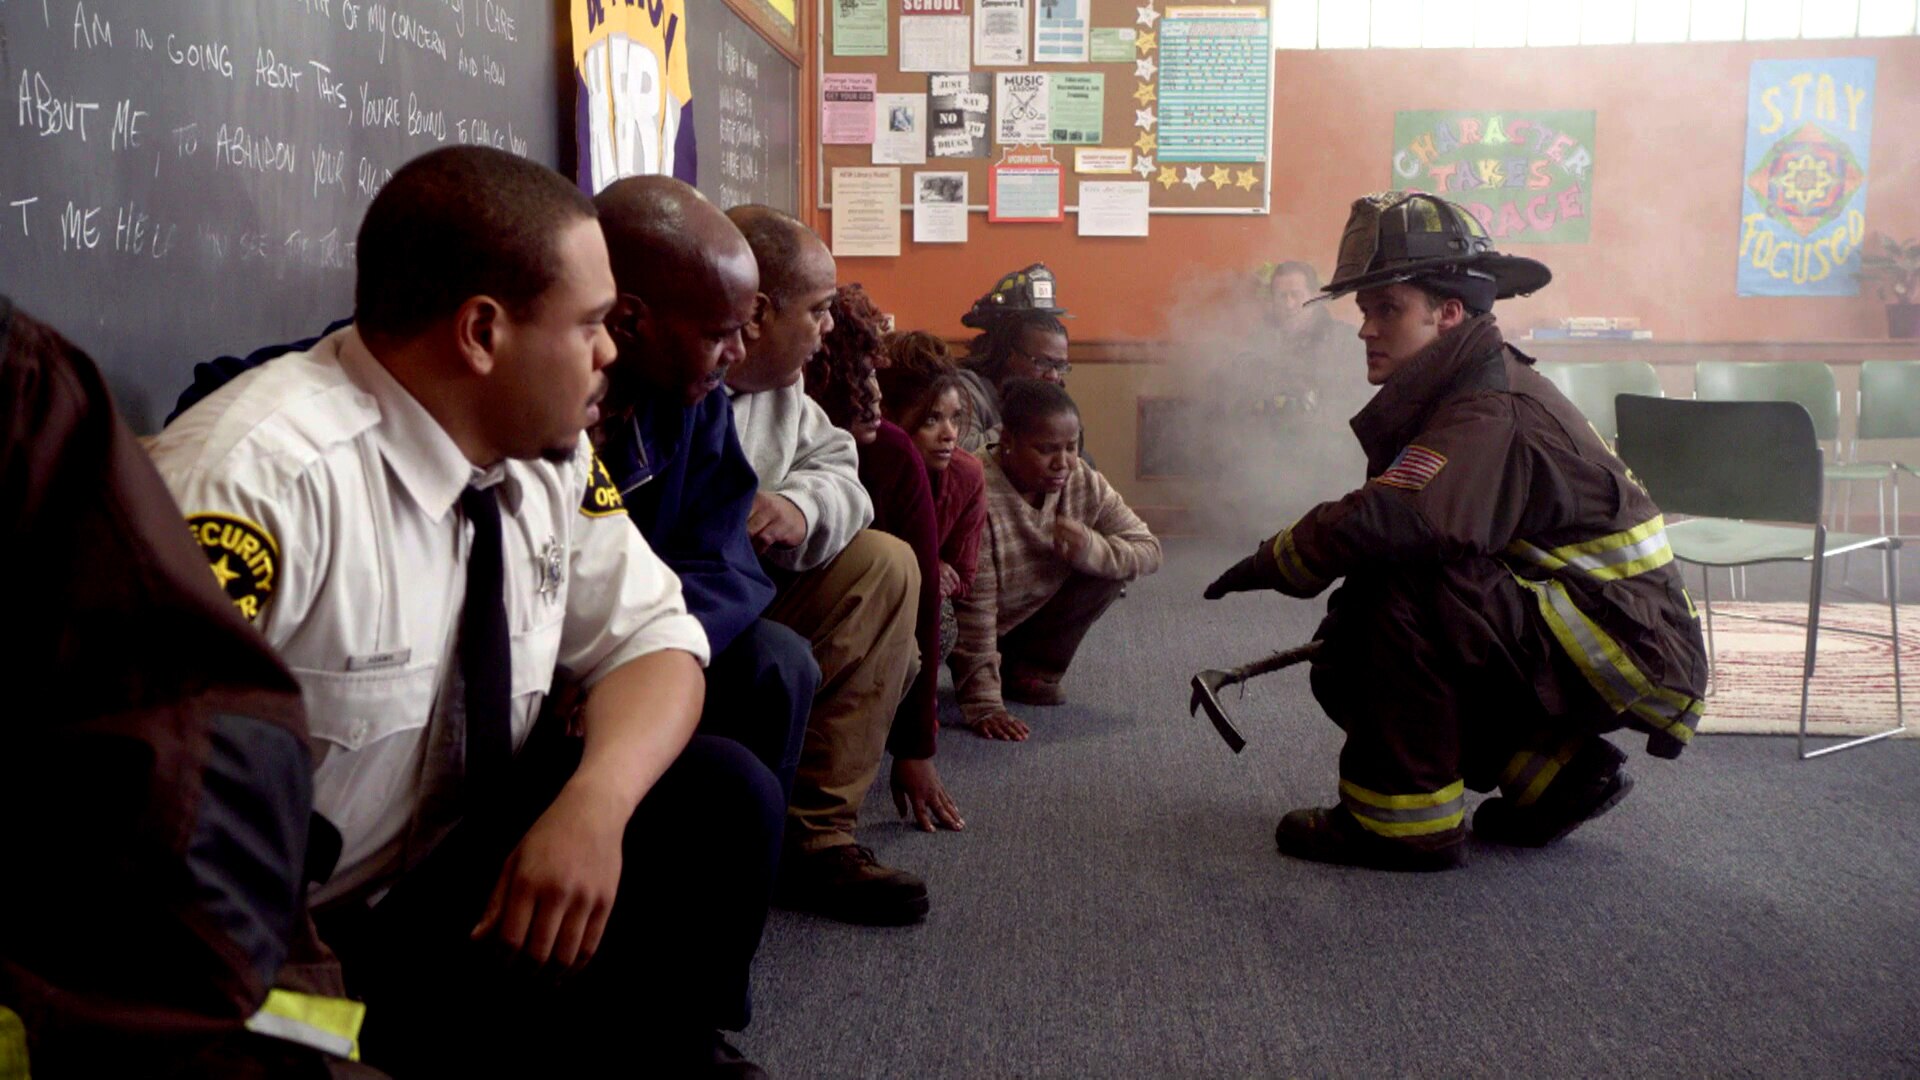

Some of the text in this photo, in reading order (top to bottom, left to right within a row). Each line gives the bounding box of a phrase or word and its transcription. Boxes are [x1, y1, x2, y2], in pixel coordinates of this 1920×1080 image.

[343, 0, 360, 31] OF
[367, 3, 386, 64] MY
[391, 12, 447, 61] CONCERN
[74, 1, 113, 49] AM
[135, 28, 153, 50] IN
[167, 33, 233, 80] GOING
[255, 47, 302, 92] ABOUT
[408, 91, 447, 142] BOUND
[940, 80, 962, 89] JUST
[1004, 75, 1044, 86] MUSIC
[939, 112, 957, 124] NO
[963, 97, 979, 106] SAY
[1759, 72, 1866, 134] STAY
[19, 69, 99, 142] ABOUT
[216, 124, 295, 174] ABANDON
[312, 144, 346, 198] YOUR
[938, 140, 968, 149] DRUGS
[1393, 115, 1591, 179] CHARACTER
[1429, 156, 1552, 193] TAKES
[61, 201, 101, 251] ME
[1406, 182, 1584, 238] RAGE
[1739, 209, 1866, 285] FOCUSED
[189, 521, 274, 591] CURITY
